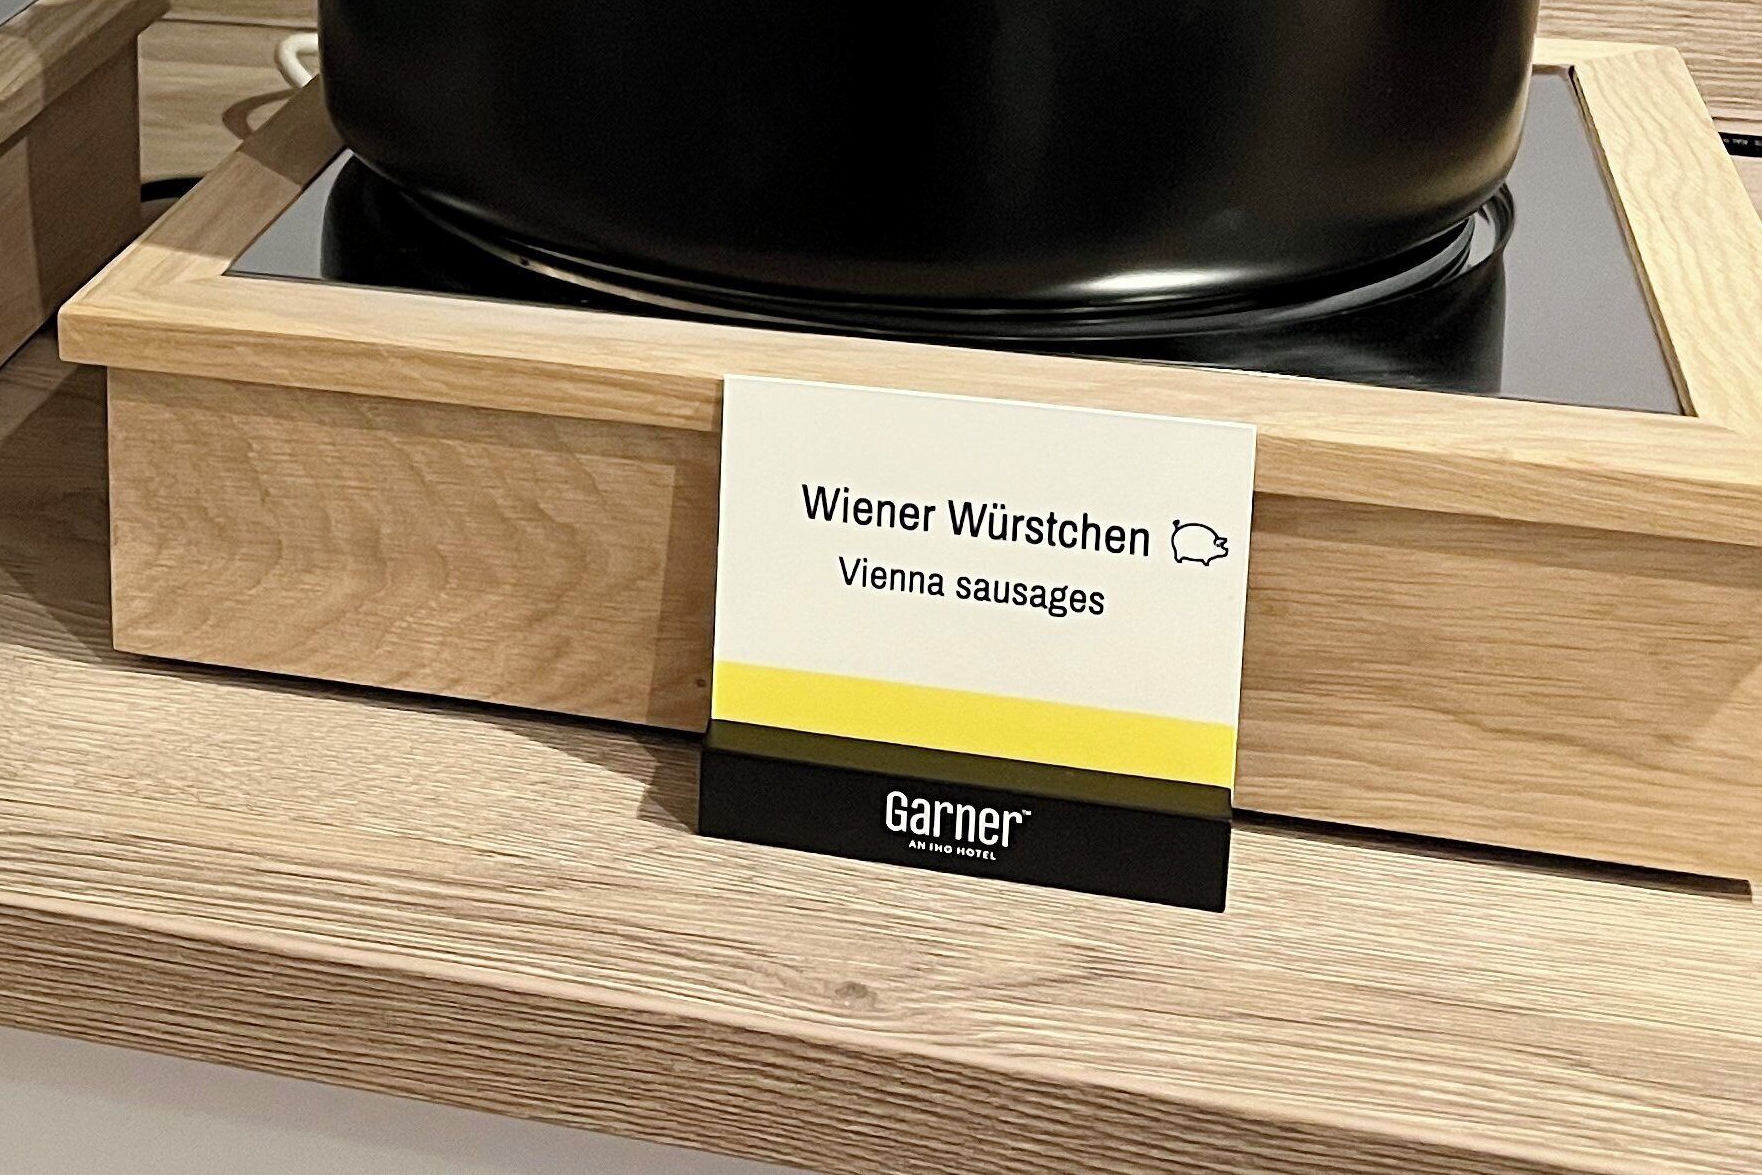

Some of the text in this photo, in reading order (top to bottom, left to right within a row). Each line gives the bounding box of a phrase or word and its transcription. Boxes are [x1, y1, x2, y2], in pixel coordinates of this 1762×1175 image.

[802, 484, 1150, 557] Wiener Würstchen
[838, 556, 1105, 618] Vienna sausages
[908, 839, 926, 850] AN
[956, 847, 997, 861] HOTEL
